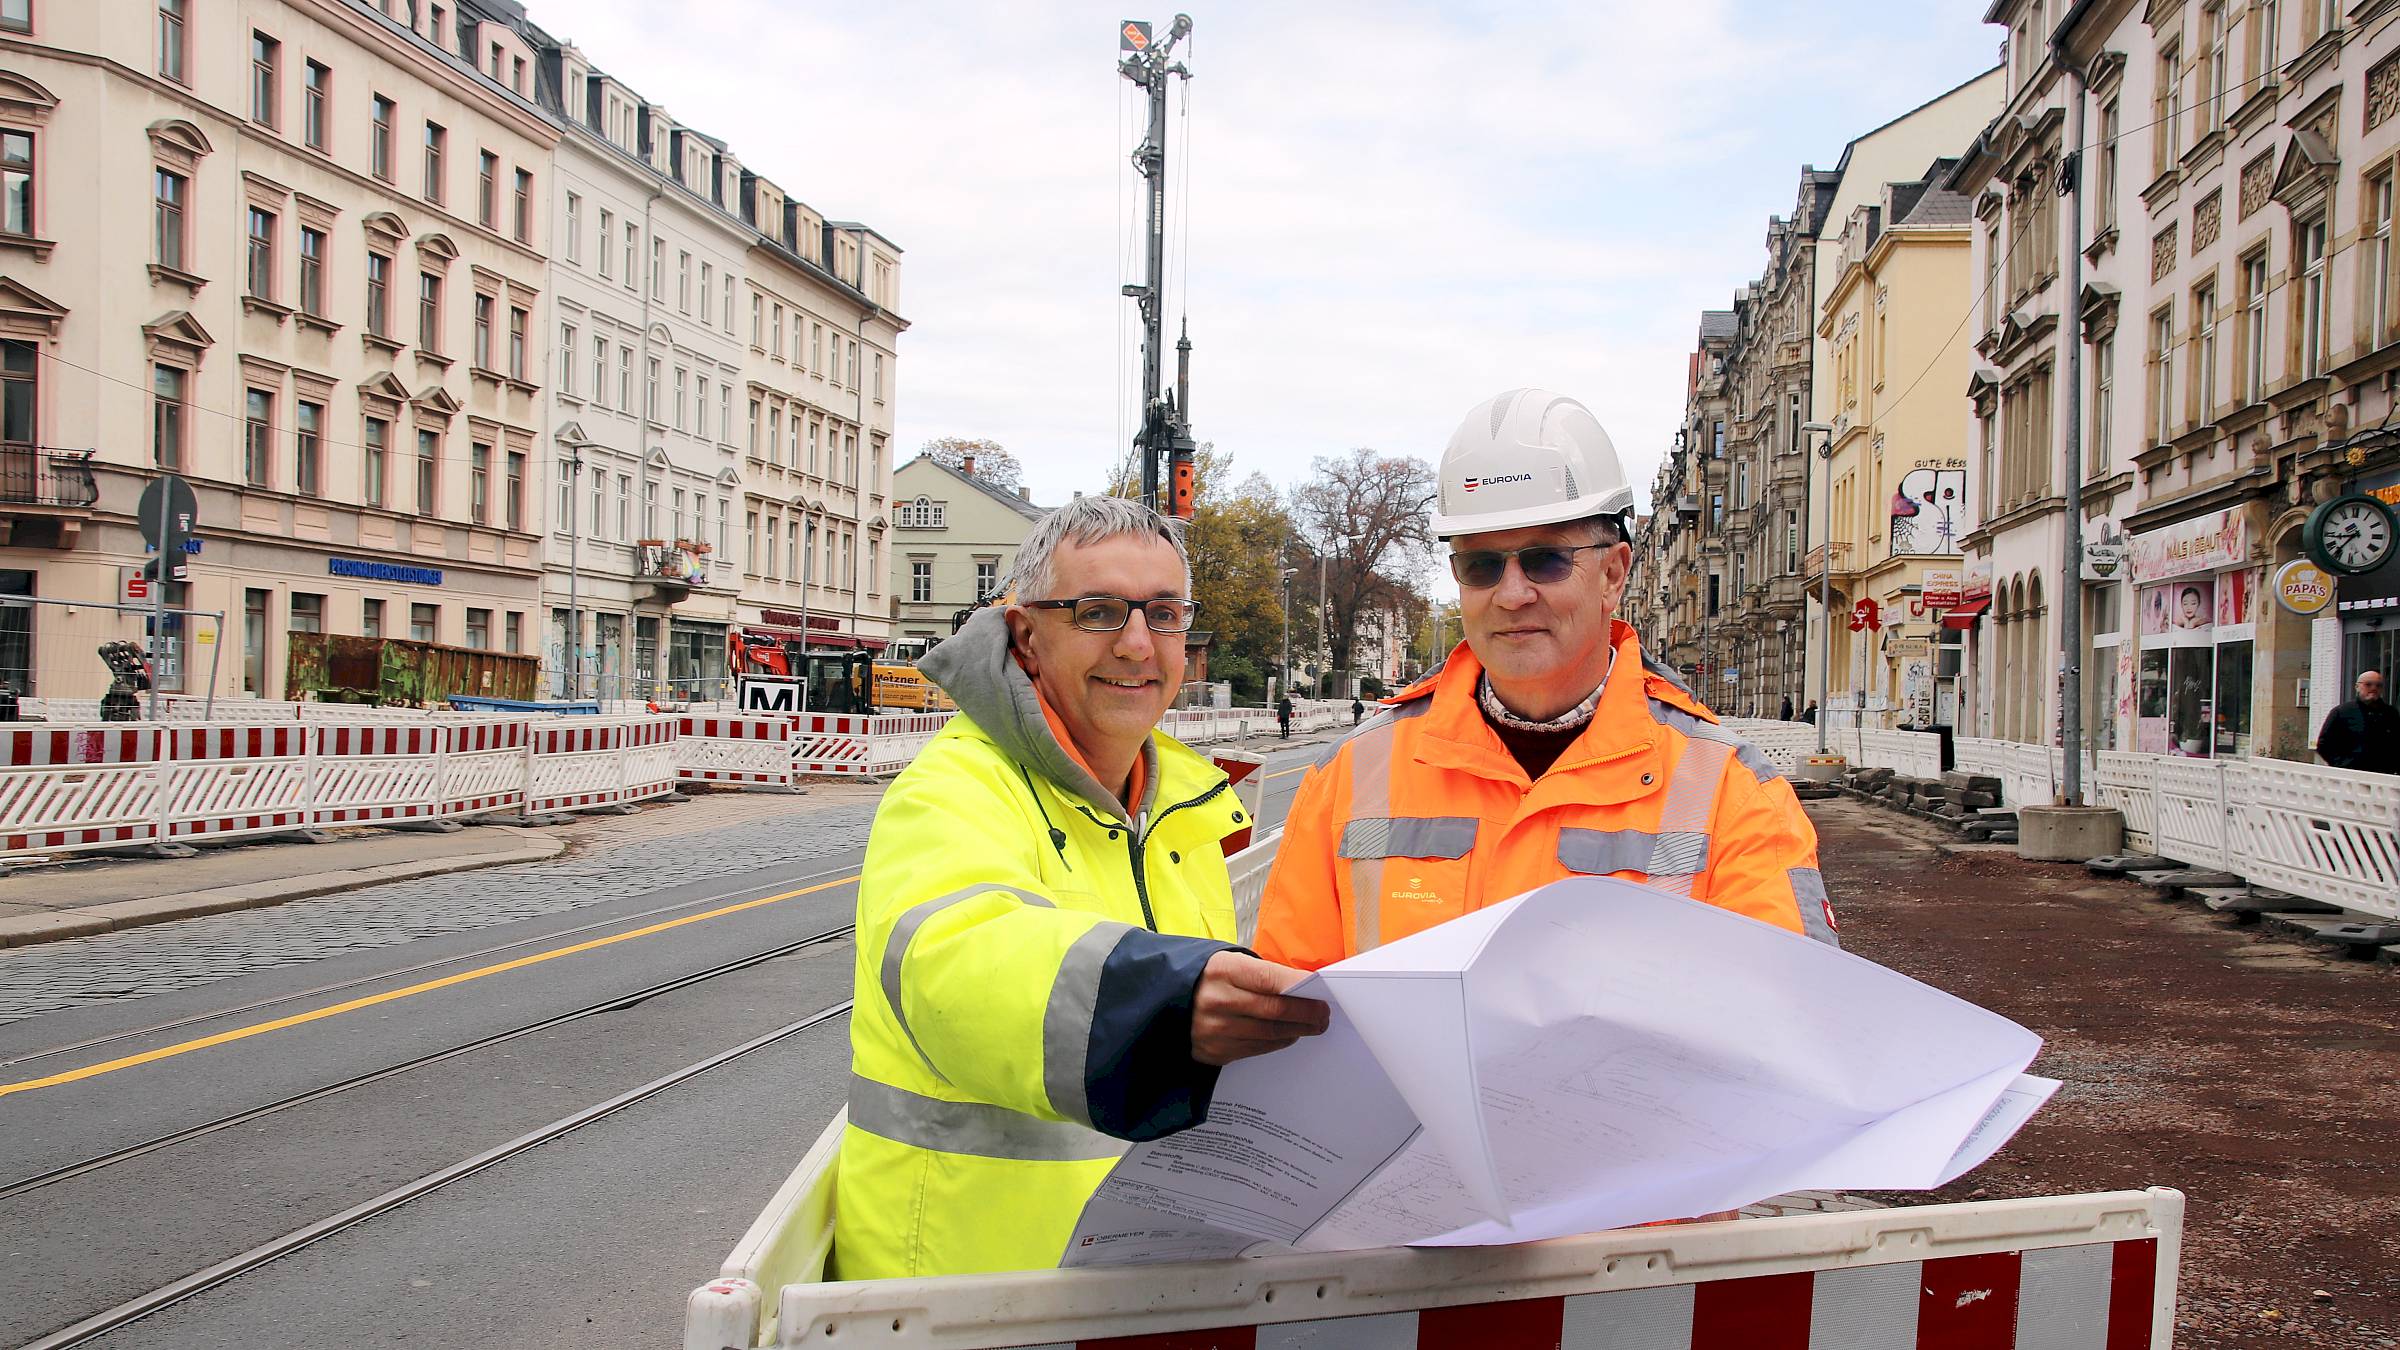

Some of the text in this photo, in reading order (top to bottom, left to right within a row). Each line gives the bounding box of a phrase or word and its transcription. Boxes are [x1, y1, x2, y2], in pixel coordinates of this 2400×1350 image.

[1914, 459, 1941, 468] GUTE
[1482, 474, 1532, 486] EUROVIA
[2285, 584, 2326, 597] PAPA'S
[874, 674, 920, 685] Metzner
[750, 687, 793, 712] M
[1391, 891, 1437, 900] EUROVIA
[1097, 1231, 1145, 1240] OBERMEYER
